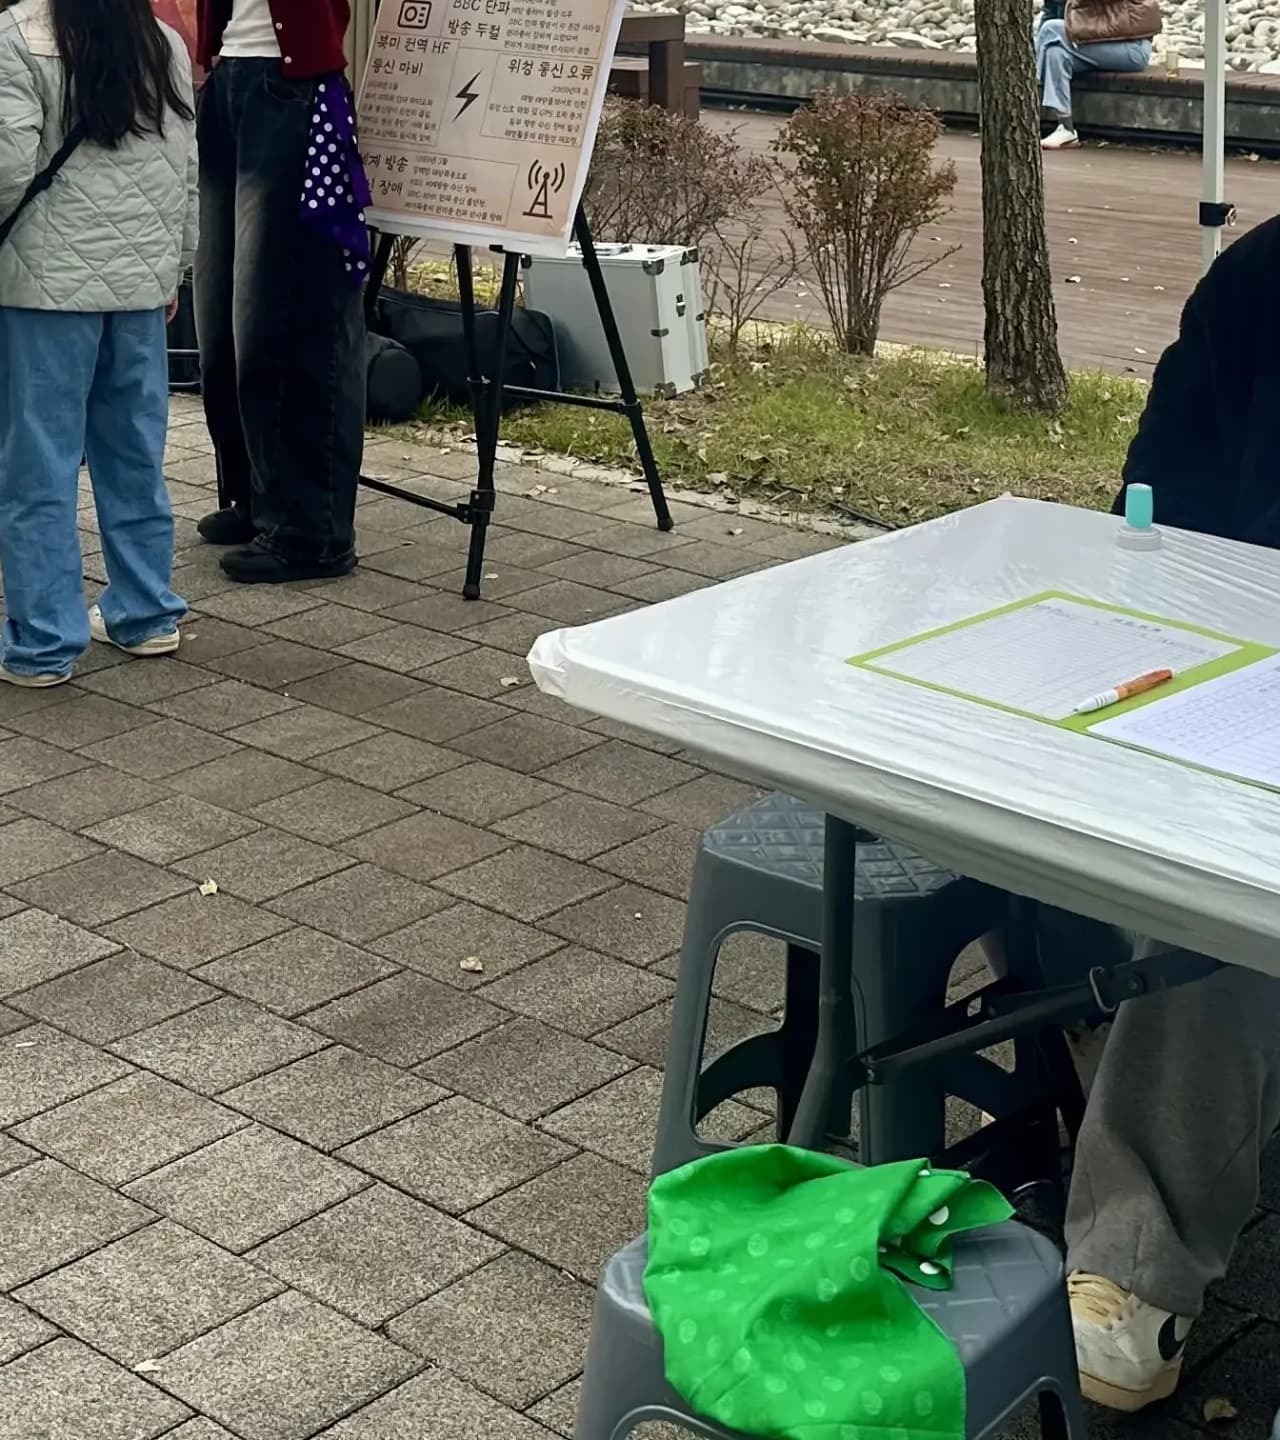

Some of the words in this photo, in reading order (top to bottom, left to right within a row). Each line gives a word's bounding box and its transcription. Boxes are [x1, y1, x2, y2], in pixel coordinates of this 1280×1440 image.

[485, 0, 511, 16] 단파
[448, 18, 472, 36] 방송
[377, 34, 401, 49] 북미
[432, 40, 451, 55] HF
[371, 58, 395, 75] 통신
[399, 61, 423, 76] 마비
[508, 58, 534, 76] 위성
[538, 61, 564, 79] 통신
[566, 65, 594, 81] 오류
[385, 155, 409, 173] 방송
[379, 179, 404, 197] 장애
